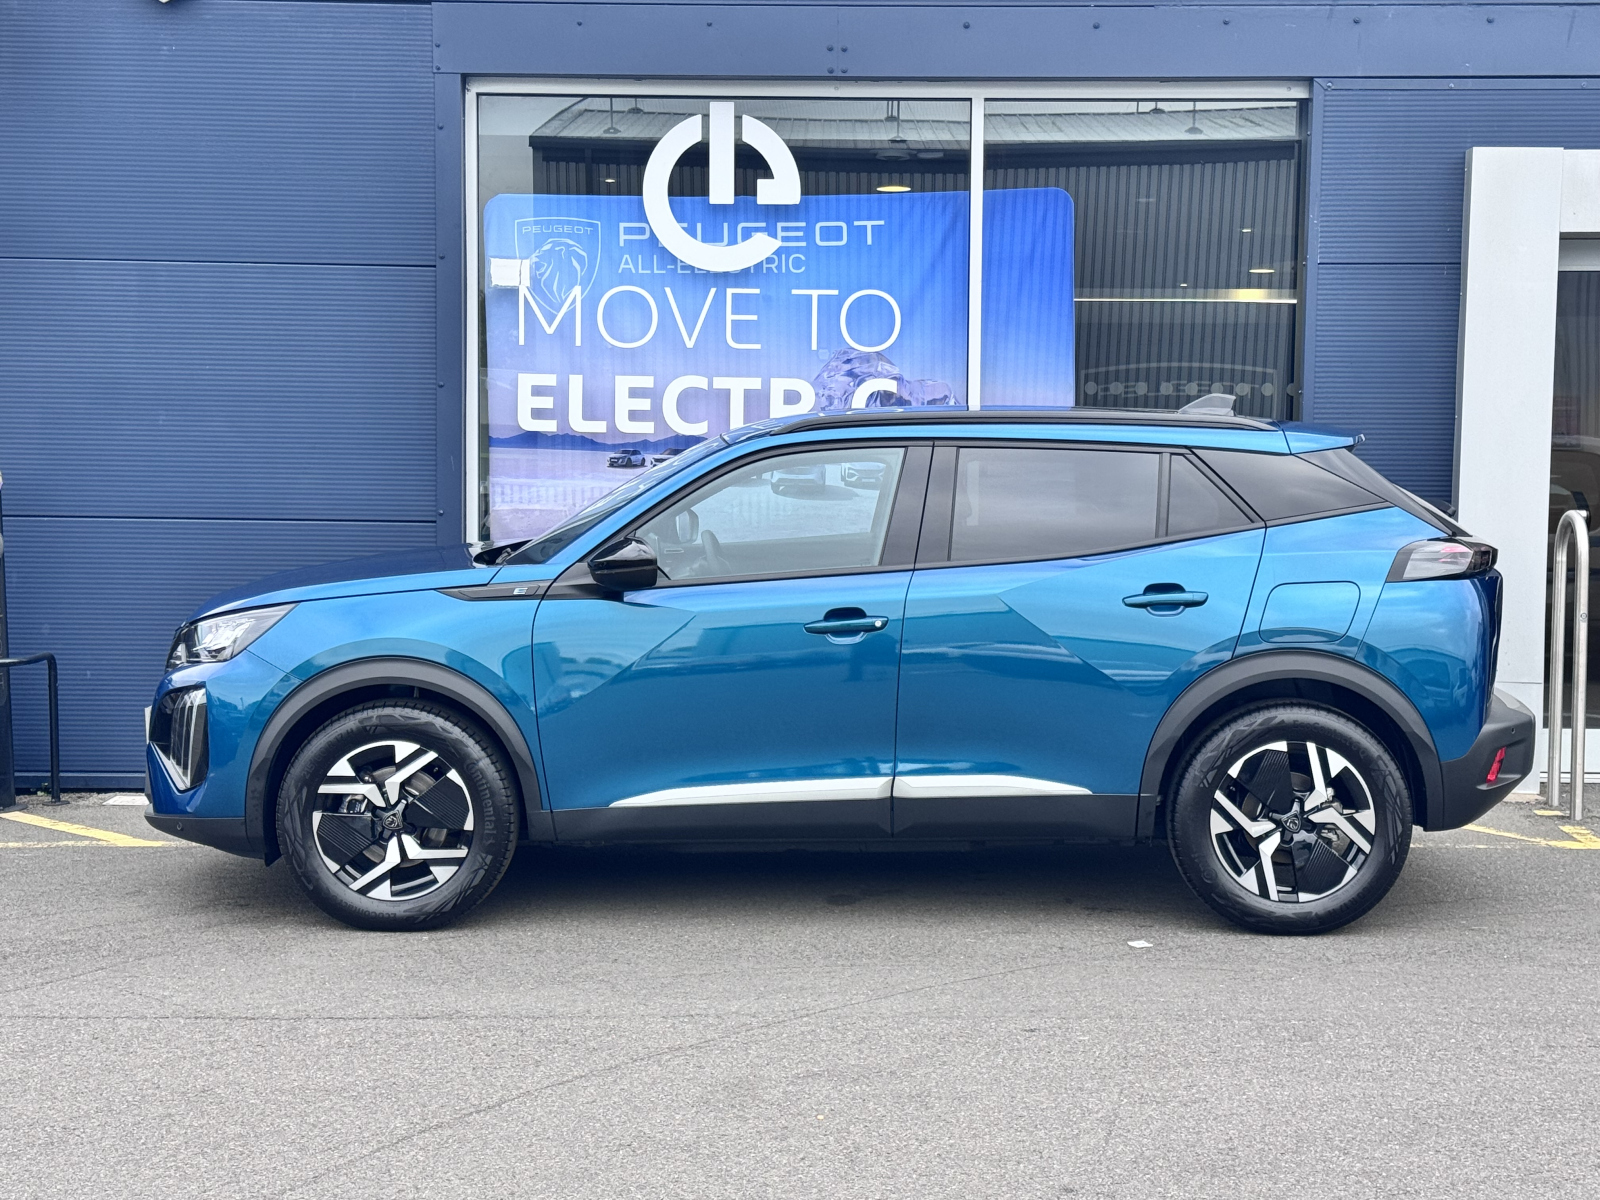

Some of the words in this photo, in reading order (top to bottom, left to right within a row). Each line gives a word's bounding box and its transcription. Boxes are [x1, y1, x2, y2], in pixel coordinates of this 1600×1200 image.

[522, 224, 594, 235] PEUGEOT
[618, 253, 806, 274] ALL-ERIC
[517, 284, 761, 349] MOVE
[791, 288, 901, 352] TO
[463, 759, 498, 835] Continental
